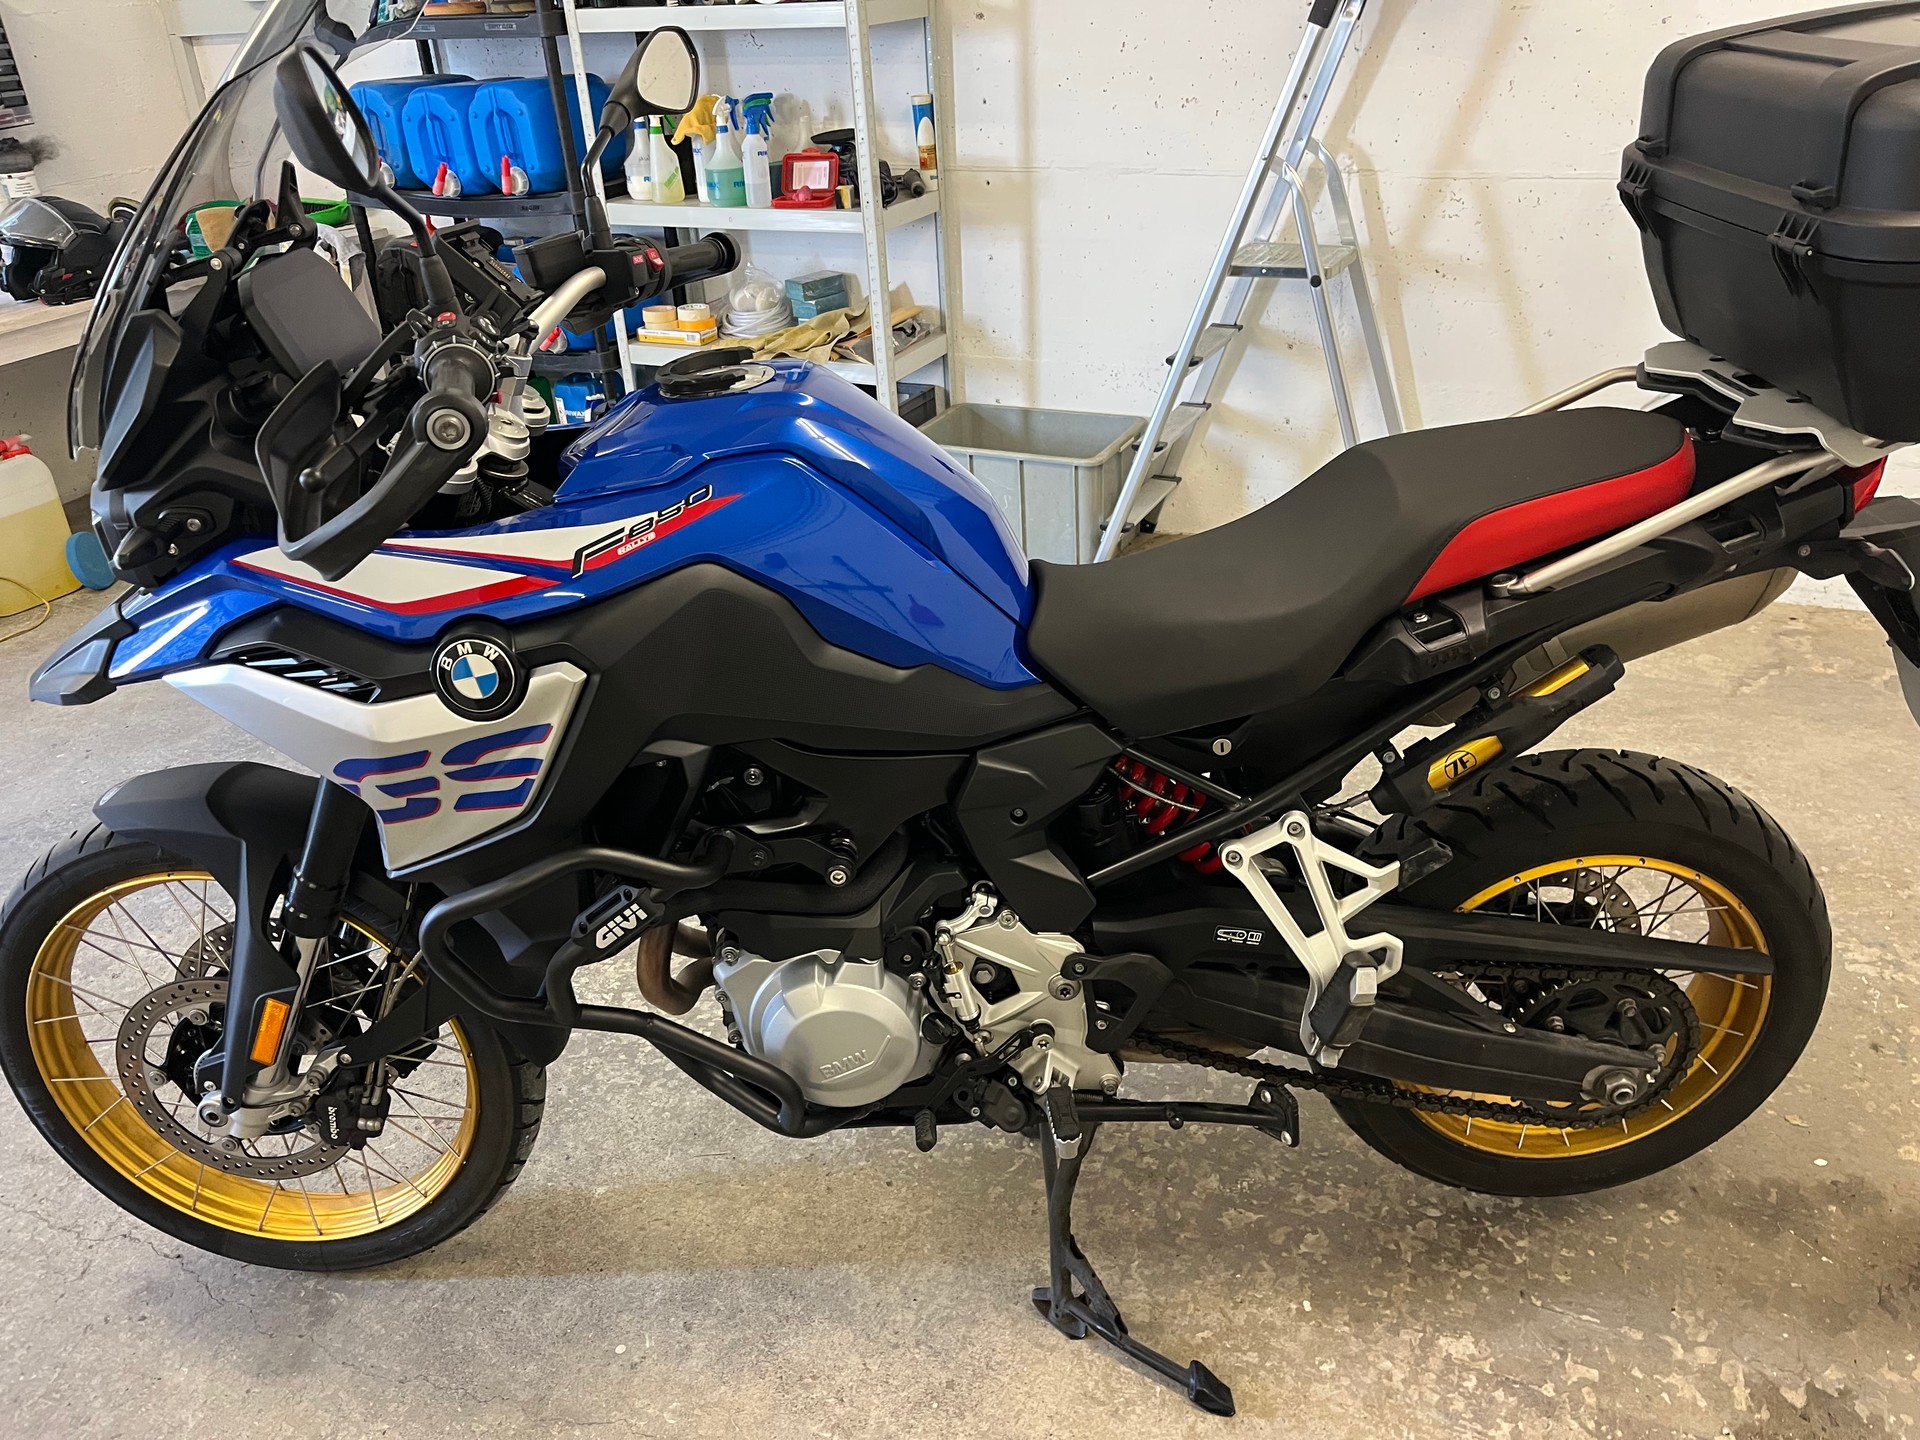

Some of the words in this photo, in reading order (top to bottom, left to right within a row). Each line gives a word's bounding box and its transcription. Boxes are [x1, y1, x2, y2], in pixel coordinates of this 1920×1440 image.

[440, 641, 500, 671] BMW
[333, 723, 553, 824] GS
[1445, 751, 1477, 778] ZF
[595, 902, 648, 949] GIVI
[820, 1049, 869, 1079] BMW
[327, 1106, 340, 1140] brembo
